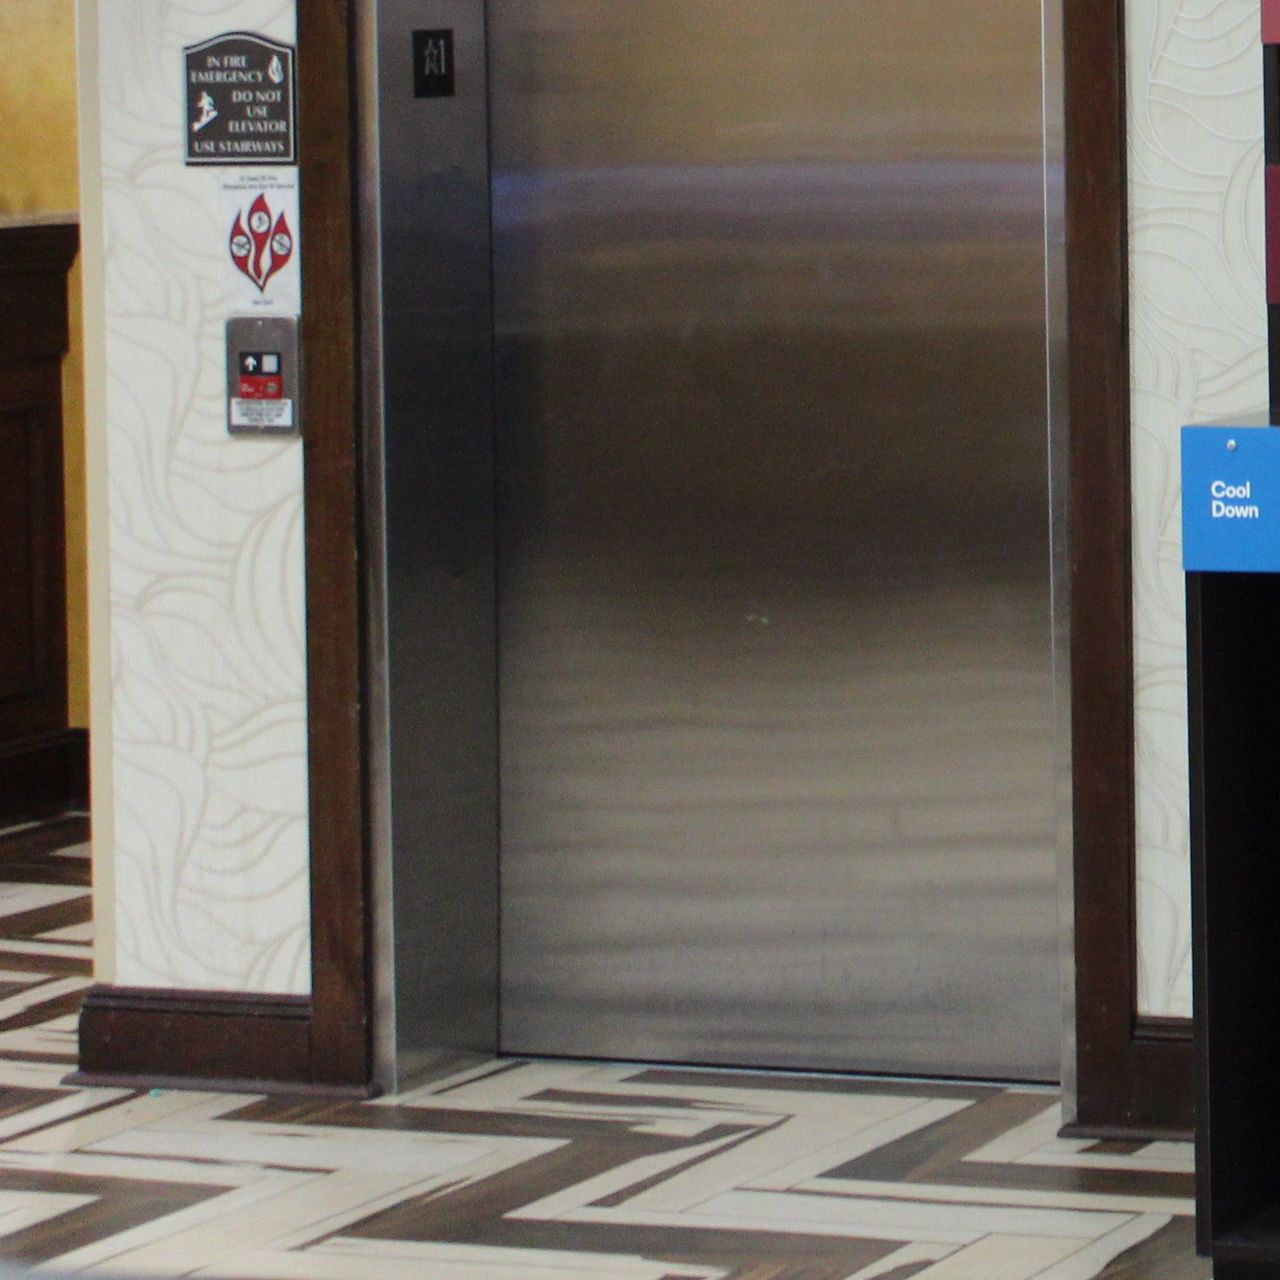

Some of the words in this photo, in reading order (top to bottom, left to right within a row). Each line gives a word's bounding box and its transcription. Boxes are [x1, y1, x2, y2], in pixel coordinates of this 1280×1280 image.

[207, 55, 220, 68] IN
[224, 55, 247, 68] FIRE
[190, 71, 265, 83] EMERGENCY
[232, 90, 252, 103] DO
[256, 90, 282, 103] NOT
[246, 106, 268, 117] USE
[228, 121, 287, 133] ELEVATOR
[194, 141, 215, 153] USE
[218, 141, 285, 153] STAIRWAYS
[1211, 480, 1251, 499] Cool
[1211, 500, 1259, 518] Down
